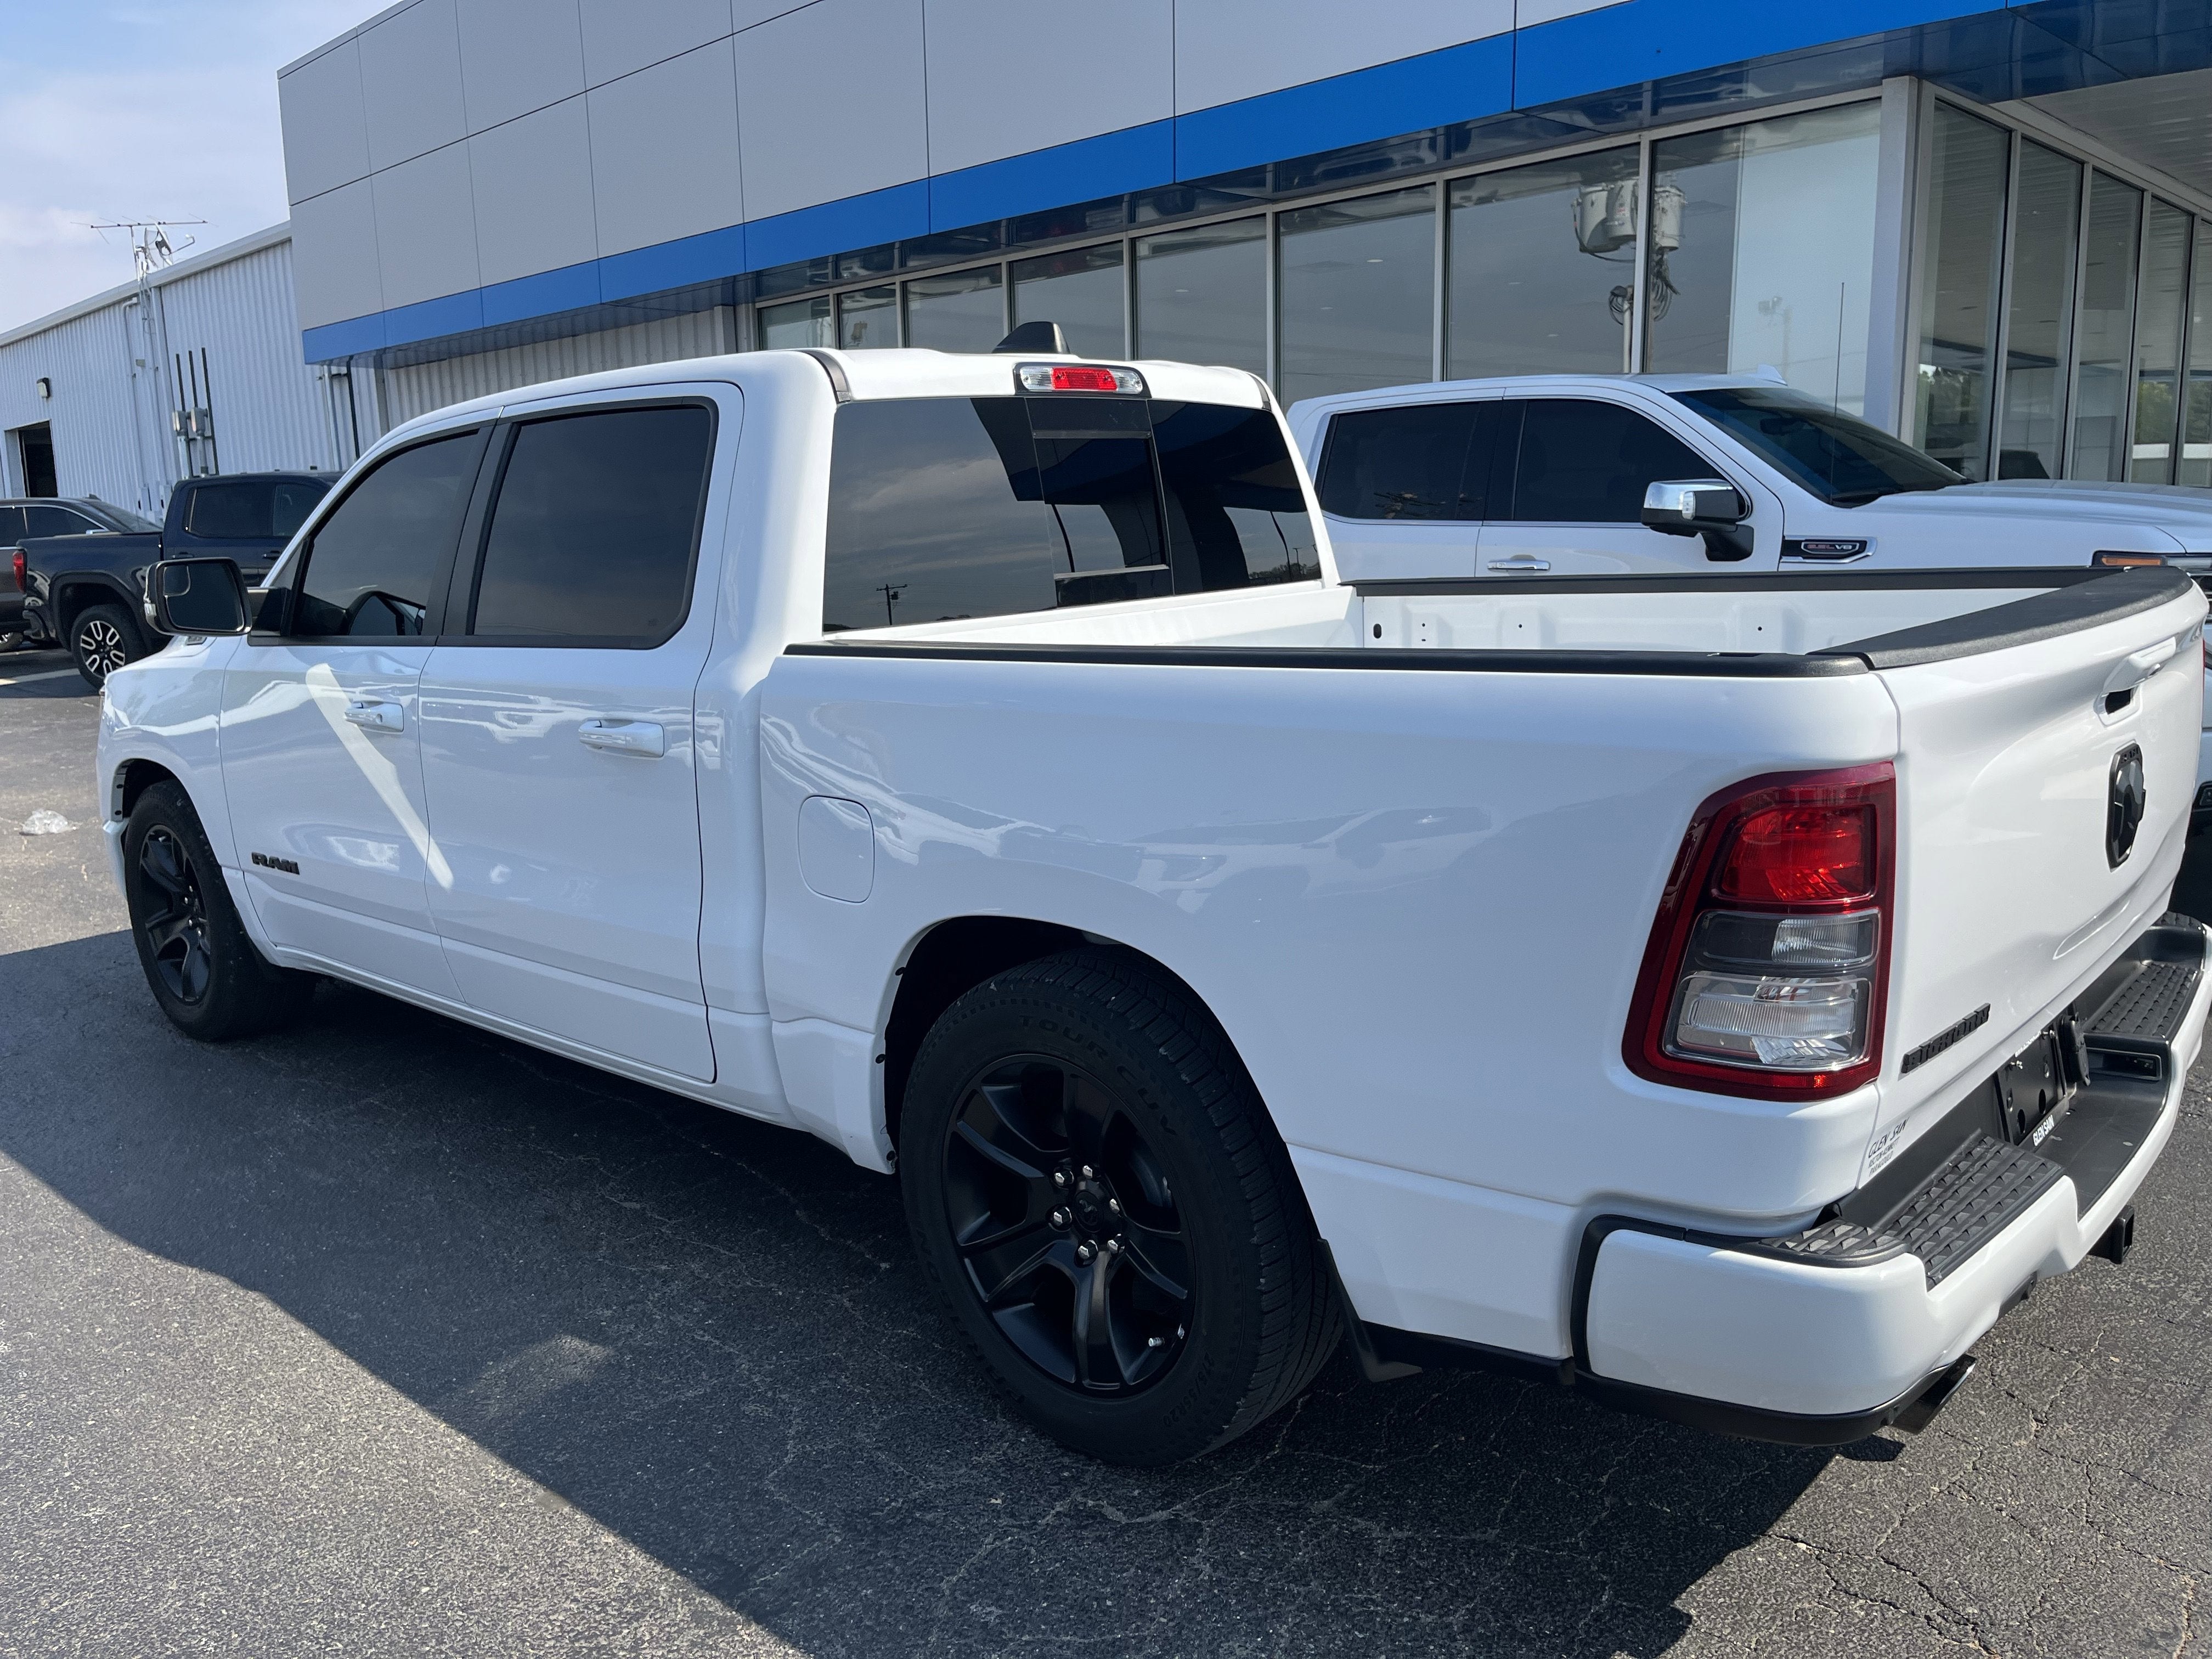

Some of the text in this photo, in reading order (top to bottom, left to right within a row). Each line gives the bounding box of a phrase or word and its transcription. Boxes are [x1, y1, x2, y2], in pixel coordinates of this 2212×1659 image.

[251, 852, 300, 875] RAM
[1018, 1014, 1177, 1136] TOUR CUV
[1868, 1131, 1891, 1159] GLEN
[2033, 1114, 2055, 1146] GLEN SAIN
[915, 1227, 1025, 1405] PARAGON
[1163, 1352, 1215, 1427] 275/55R20
